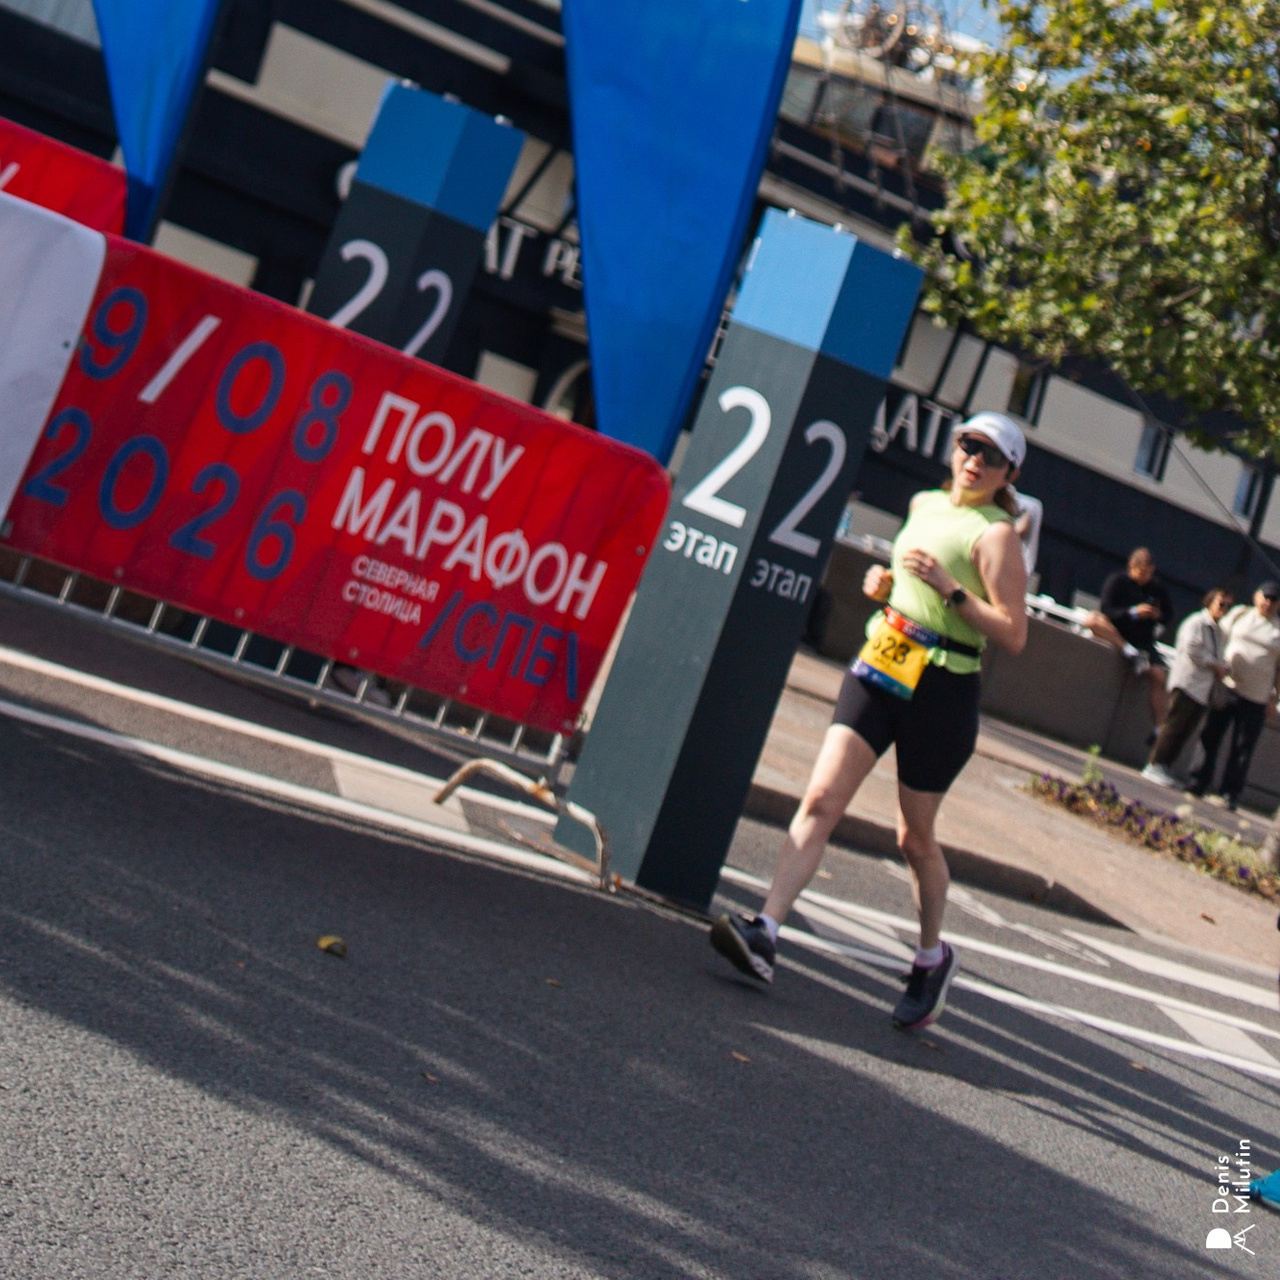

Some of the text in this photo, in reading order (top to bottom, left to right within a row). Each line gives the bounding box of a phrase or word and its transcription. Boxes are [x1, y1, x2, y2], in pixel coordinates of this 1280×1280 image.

[22, 406, 307, 582] 2026
[362, 391, 525, 502] ПОЛУ
[681, 385, 771, 529] 2
[769, 419, 847, 558] 2
[331, 465, 608, 622] МАРАФОН
[351, 553, 441, 603] СЕВЕРНАЯ
[663, 521, 738, 575] этап
[749, 558, 813, 605] этап
[341, 579, 423, 626] СТОЛИЦА
